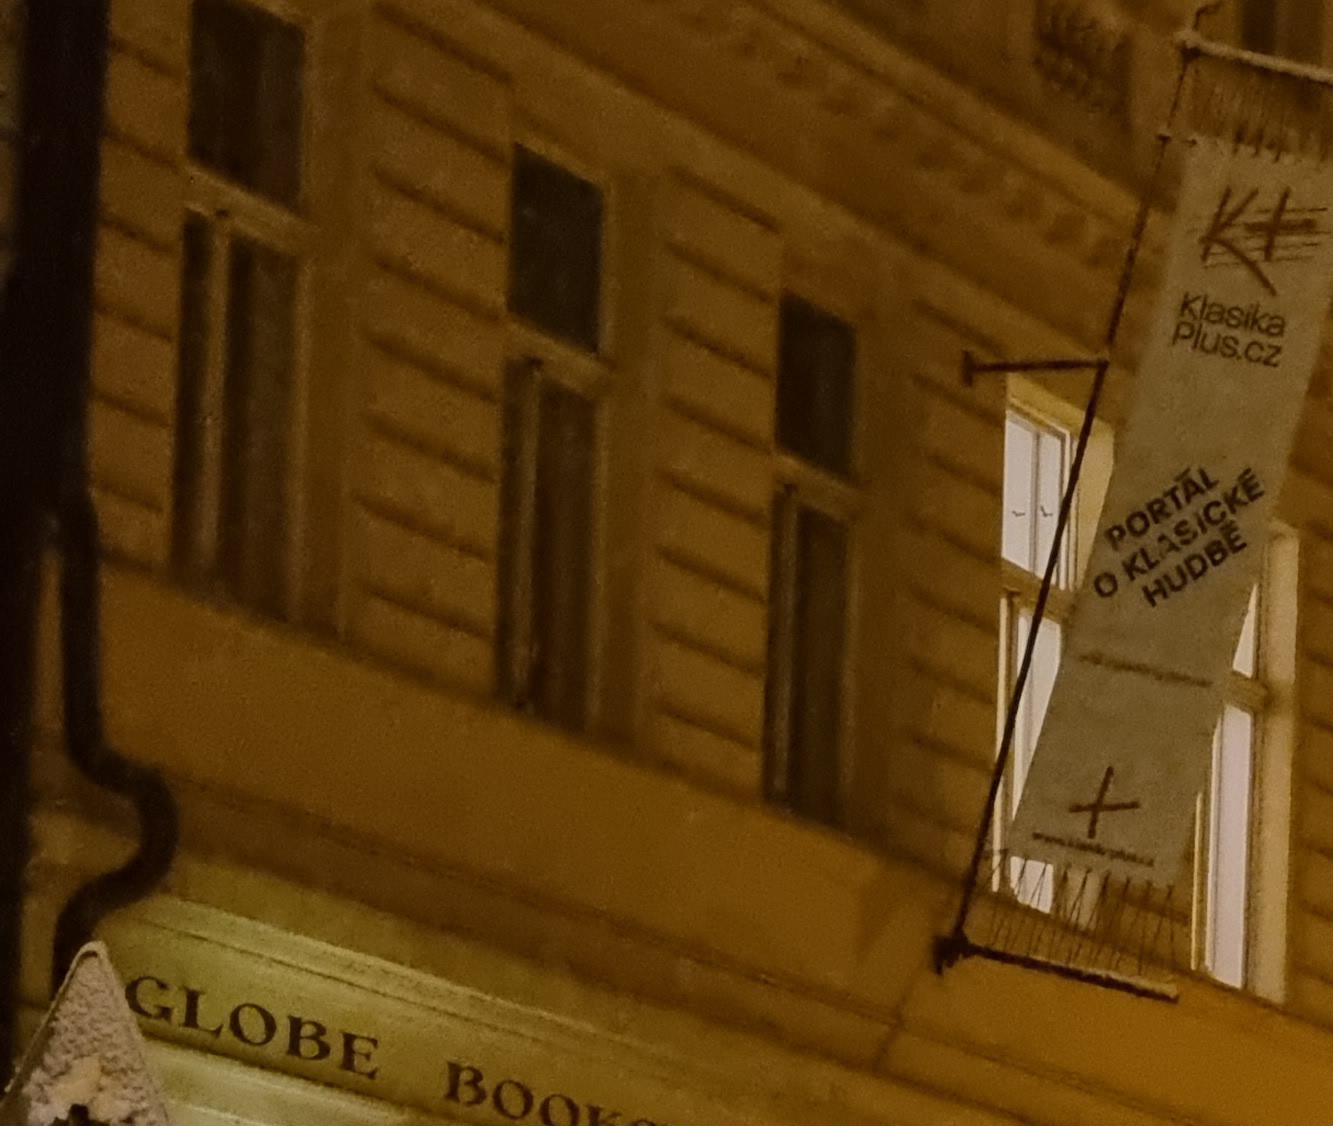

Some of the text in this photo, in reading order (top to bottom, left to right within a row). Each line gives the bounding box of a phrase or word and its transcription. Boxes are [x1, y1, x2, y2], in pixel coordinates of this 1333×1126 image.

[1180, 291, 1286, 338] Klasika
[1172, 321, 1283, 368] Plus.cz
[1105, 467, 1219, 551] PORTÁL
[1093, 572, 1118, 598] O
[125, 976, 379, 1080] GLOBE
